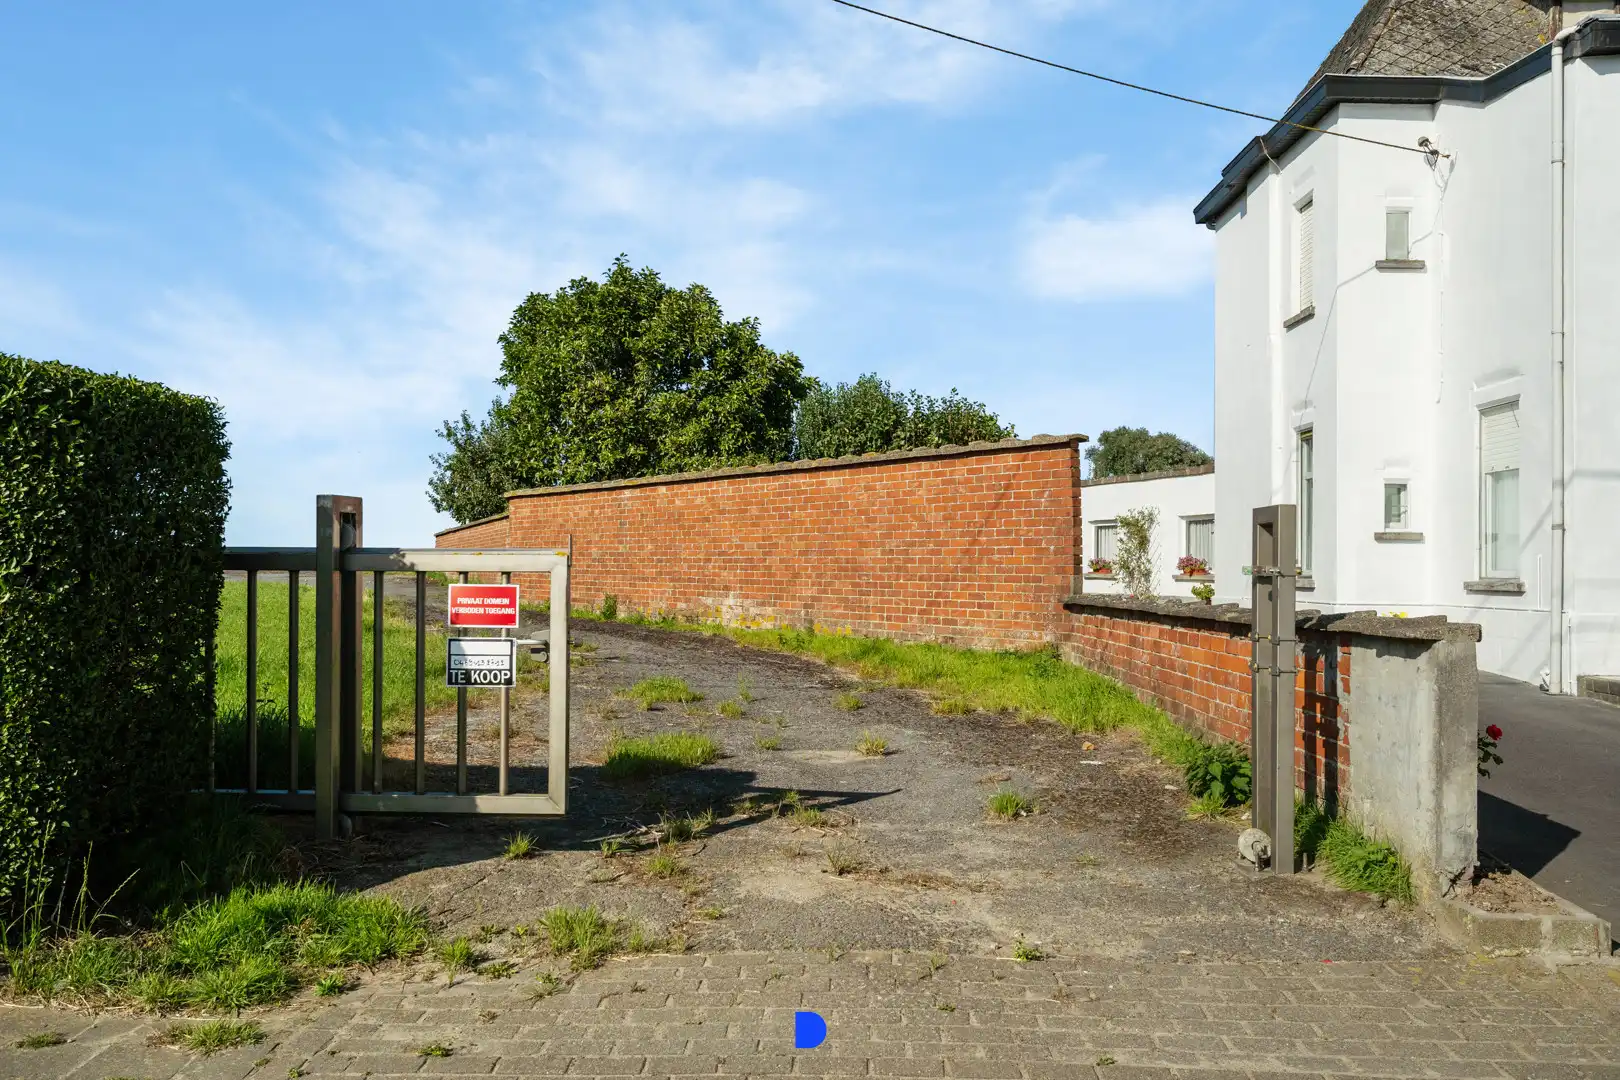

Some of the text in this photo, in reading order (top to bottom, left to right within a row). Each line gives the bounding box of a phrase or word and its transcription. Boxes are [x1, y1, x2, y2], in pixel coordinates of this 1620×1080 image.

[457, 597, 510, 605] PRIVAAT DOMEIN
[485, 607, 515, 615] TOEGANG
[450, 670, 511, 683] TE KOOP
